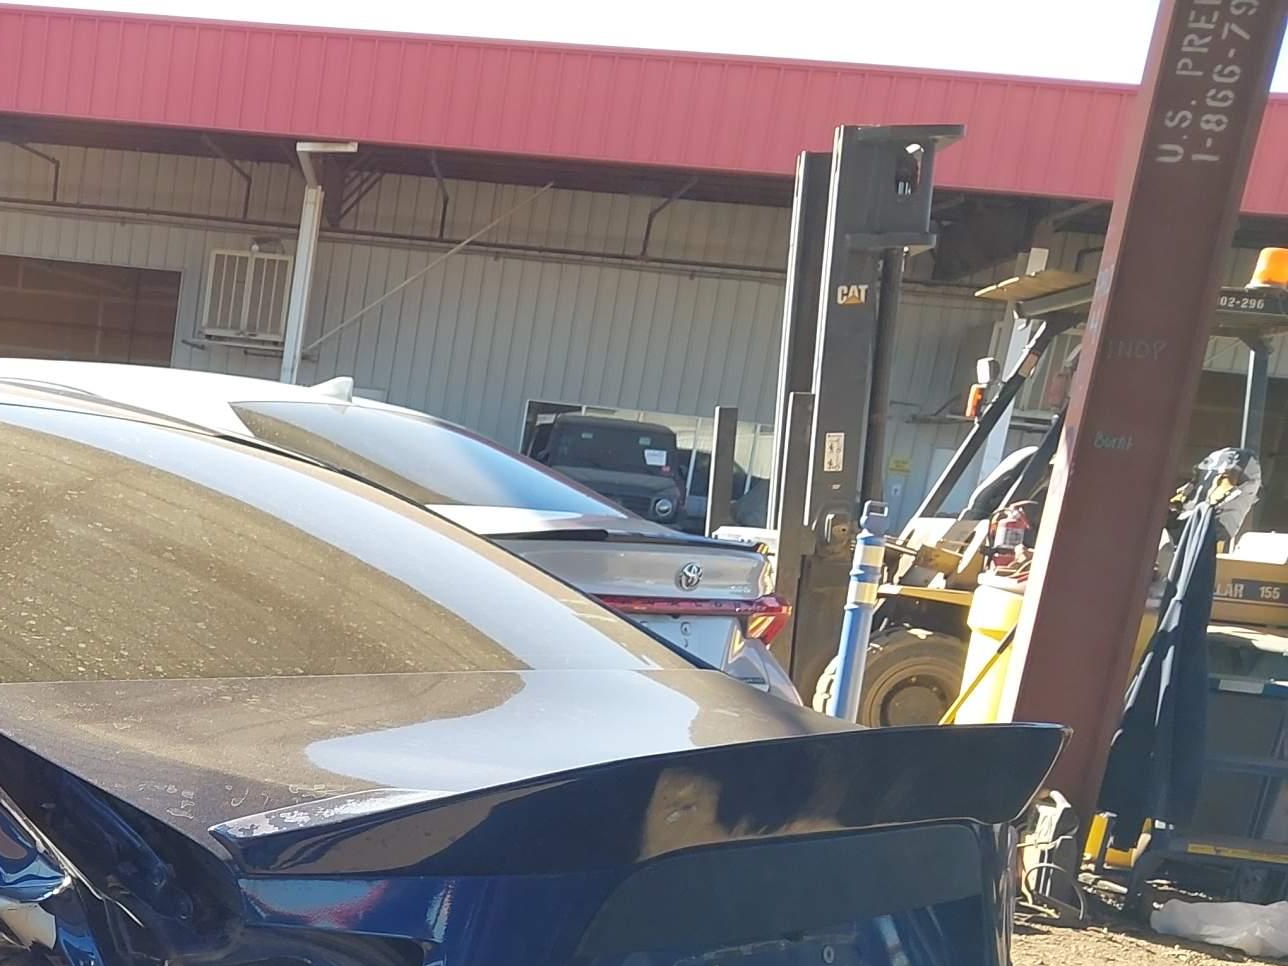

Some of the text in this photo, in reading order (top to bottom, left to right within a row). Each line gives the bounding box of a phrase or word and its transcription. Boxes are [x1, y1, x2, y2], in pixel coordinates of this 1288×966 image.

[1156, 0, 1224, 163] U.S. PRE
[837, 284, 869, 304] CAT
